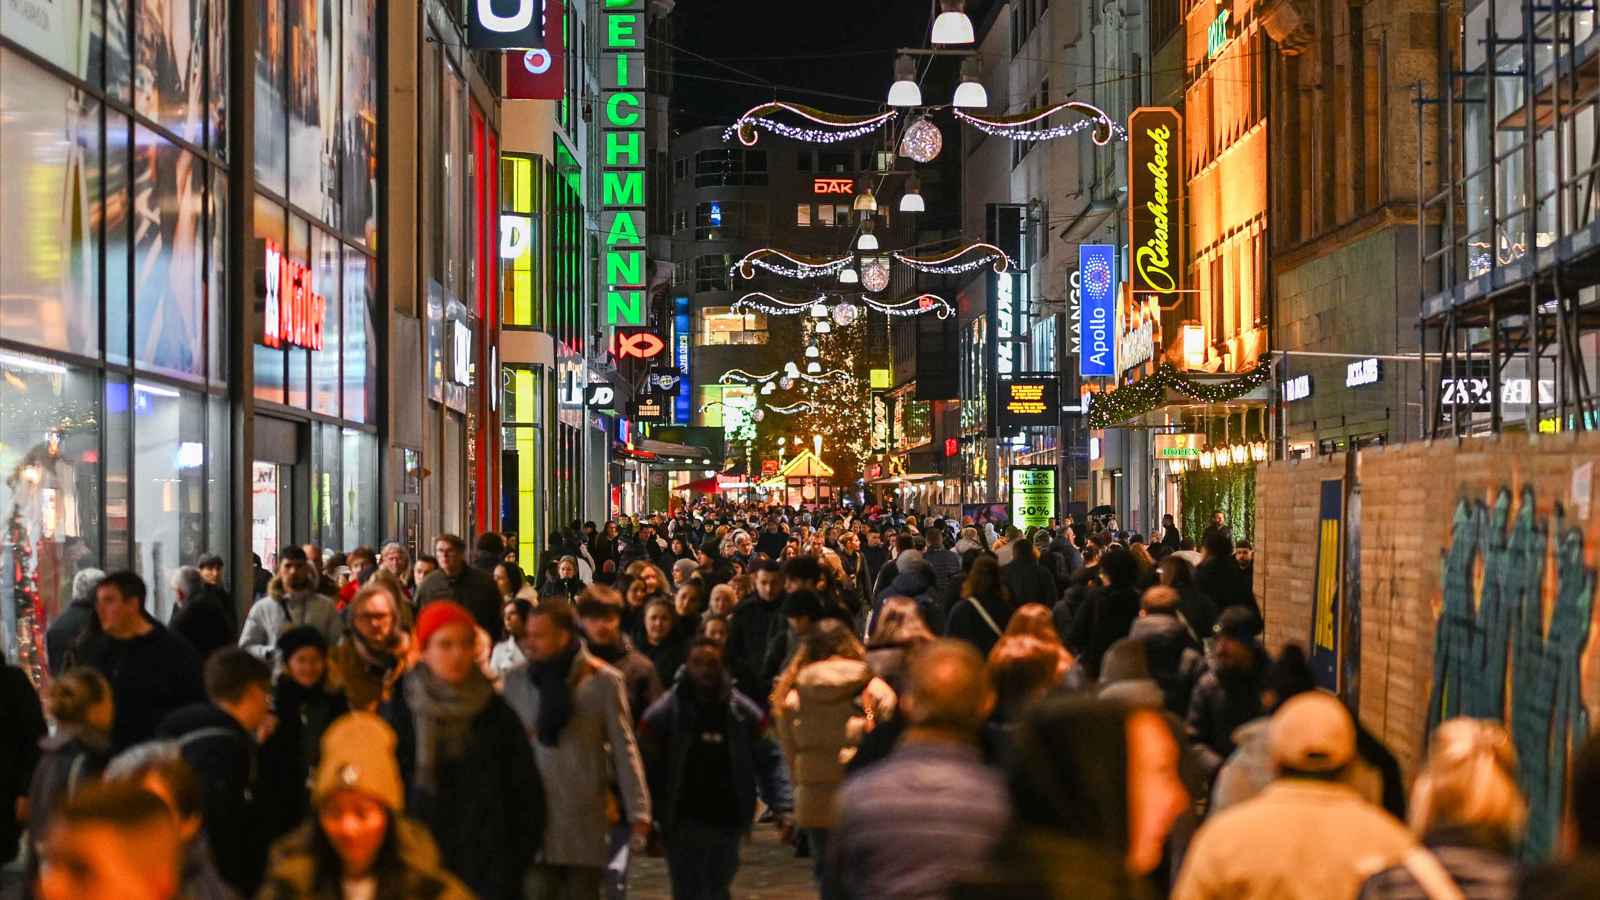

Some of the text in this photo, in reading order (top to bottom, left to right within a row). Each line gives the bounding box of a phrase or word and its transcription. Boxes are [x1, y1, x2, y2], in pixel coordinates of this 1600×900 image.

[603, 0, 644, 324] EICHMANN
[814, 178, 853, 194] DAK
[1136, 124, 1176, 294] Rüschenbeck
[1070, 270, 1080, 353] MANGO
[1089, 307, 1110, 366] Apollo
[589, 387, 614, 405] JD
[1018, 506, 1049, 516] 50%
